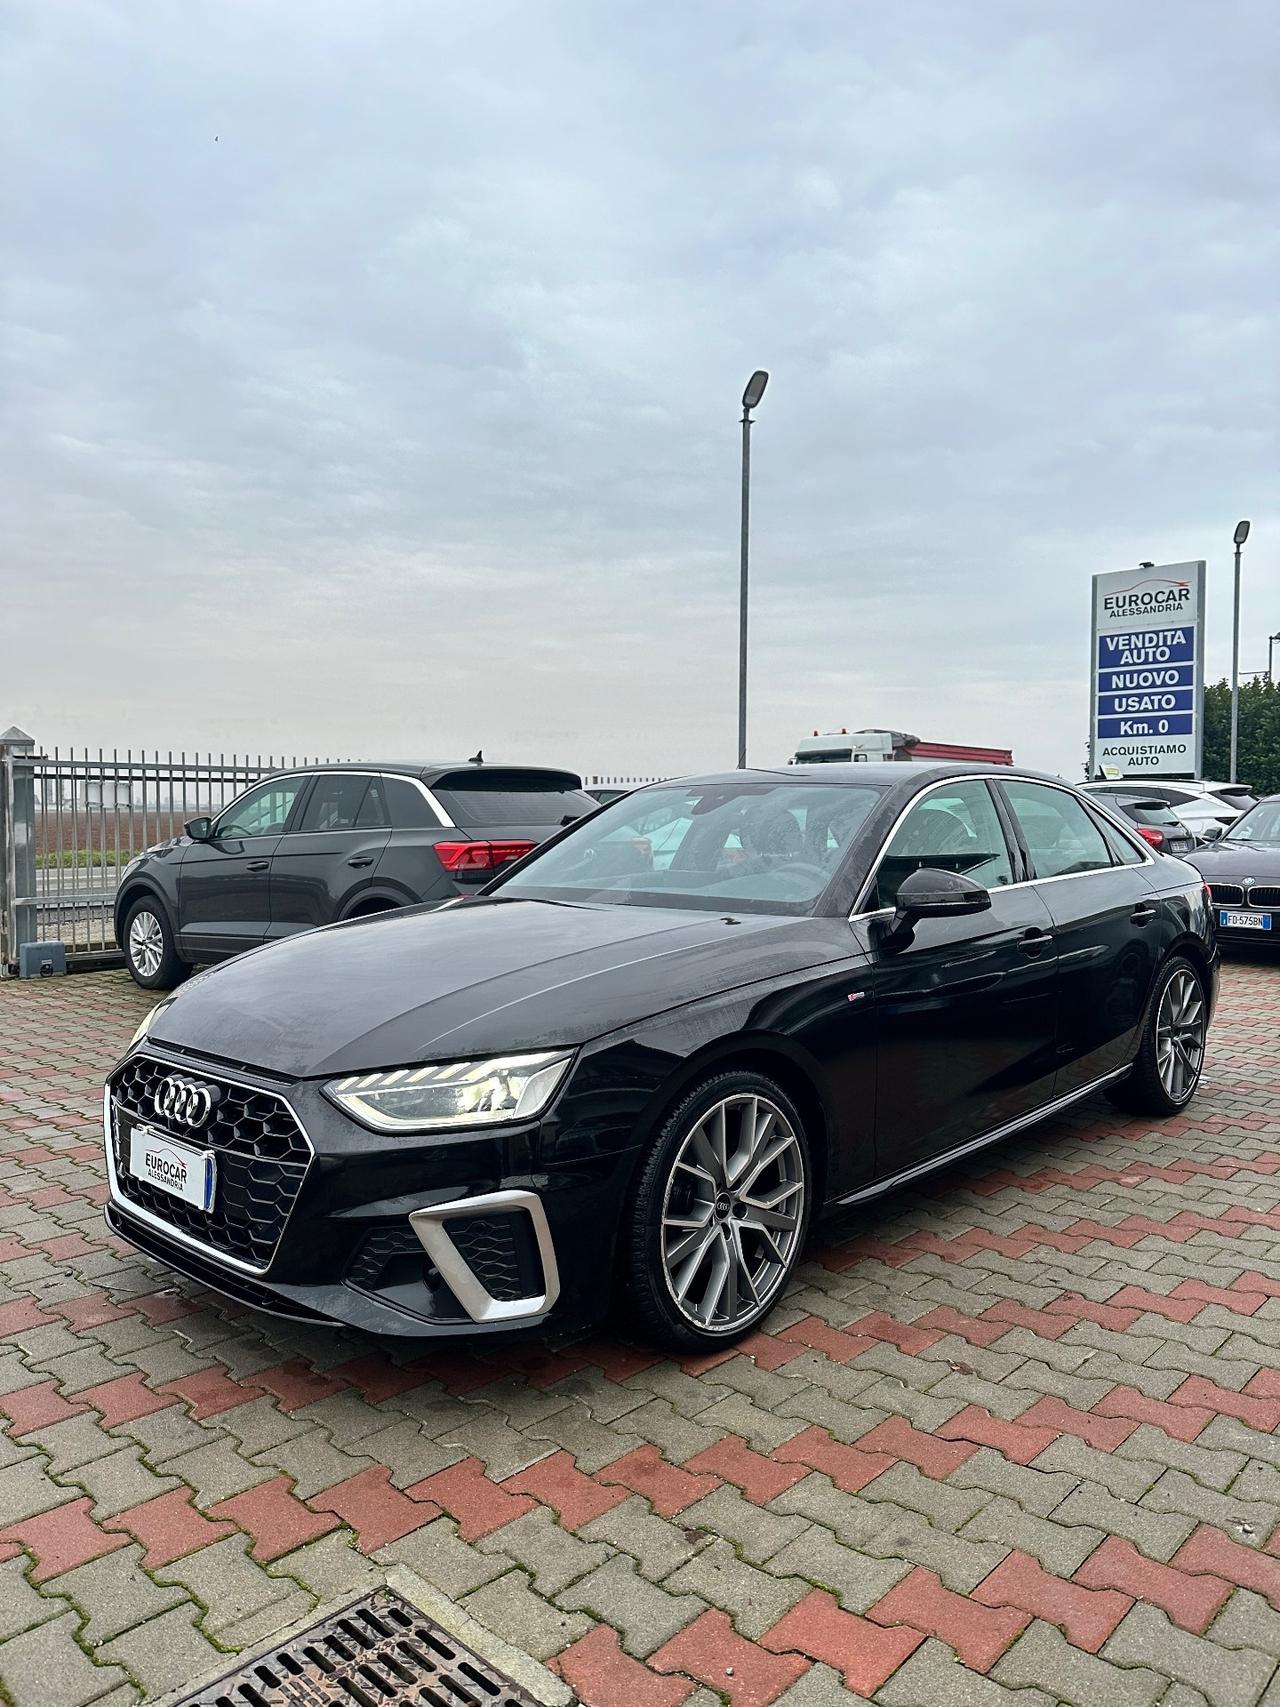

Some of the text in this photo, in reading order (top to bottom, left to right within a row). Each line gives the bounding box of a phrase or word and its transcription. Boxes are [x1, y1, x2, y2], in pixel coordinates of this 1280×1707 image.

[1104, 587, 1190, 610] EUROCAR
[1109, 602, 1183, 618] ALESSANDRIA
[1106, 630, 1186, 651] VENDITA
[1120, 646, 1170, 664] AUTO
[1111, 670, 1180, 689] NUOVO
[1114, 694, 1176, 712] USATO
[1120, 719, 1169, 736] Km. 0
[1102, 744, 1187, 757] ACQUISTIAMO
[1128, 756, 1160, 766] AUTO
[146, 1153, 187, 1183] EUROCAR
[148, 1169, 183, 1192] ALESSANDRIA
